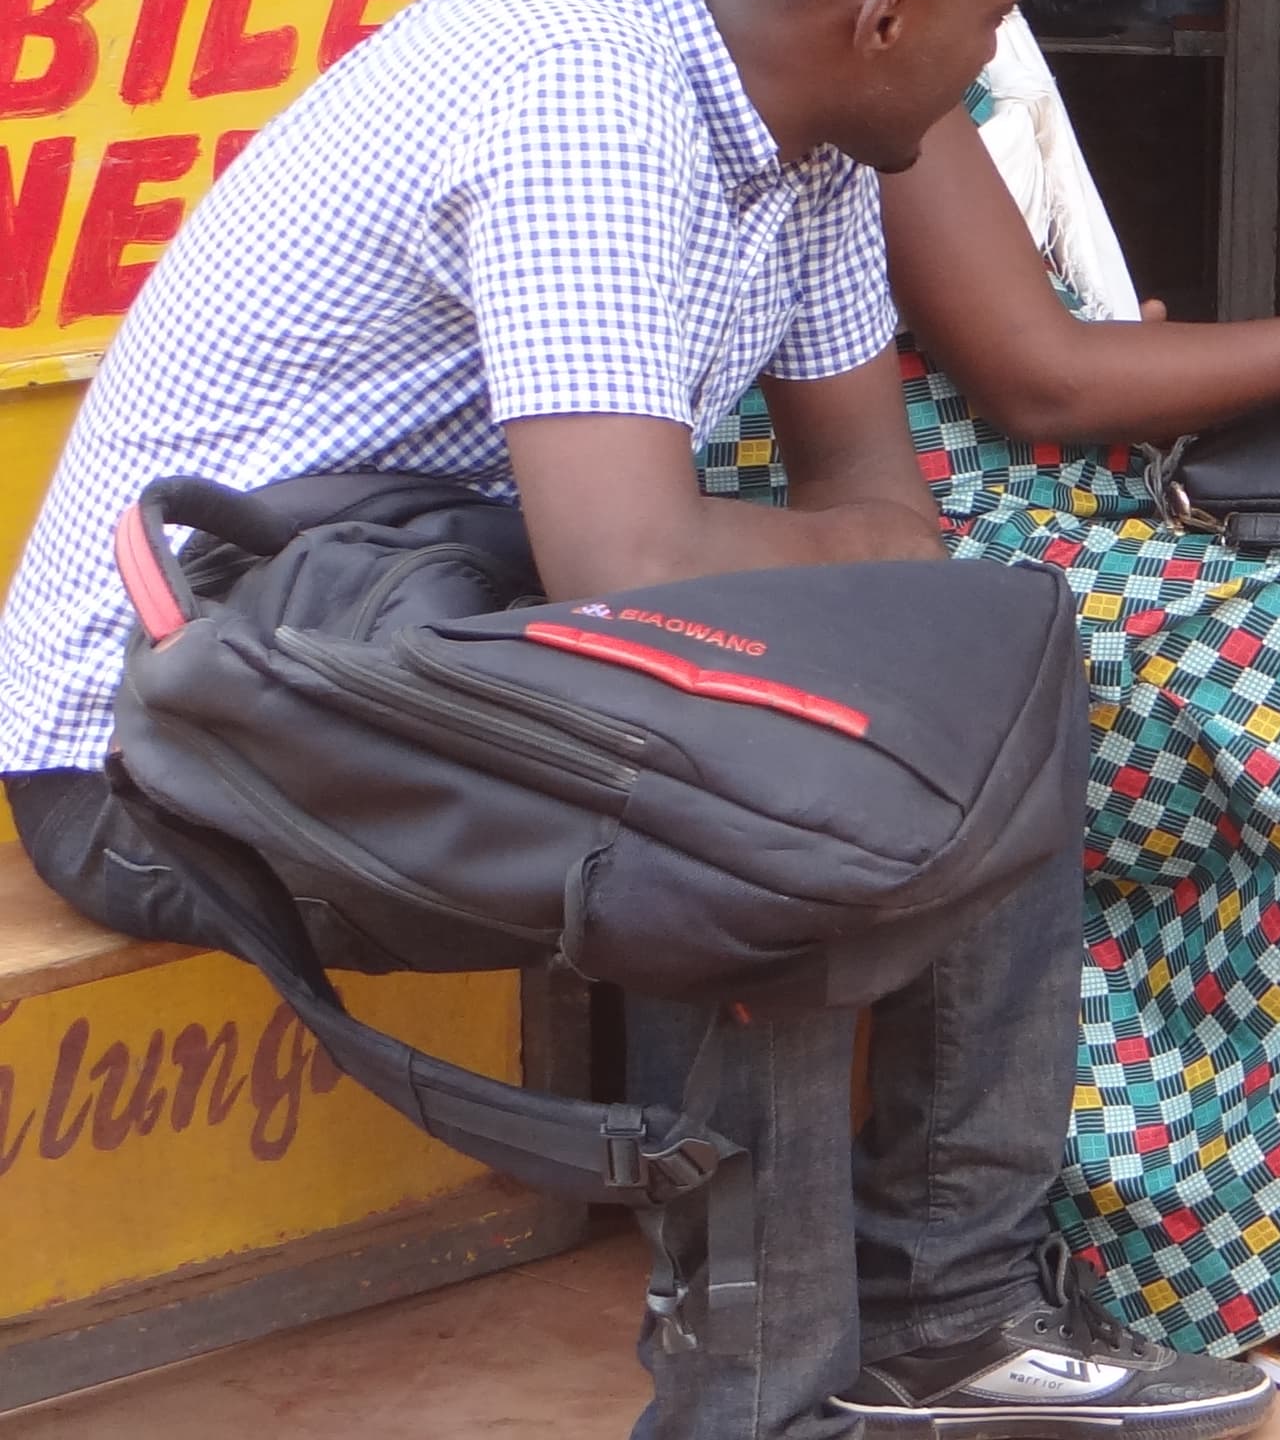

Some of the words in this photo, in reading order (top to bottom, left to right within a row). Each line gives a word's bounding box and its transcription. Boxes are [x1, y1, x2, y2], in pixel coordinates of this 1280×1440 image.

[0, 129, 269, 329] NE
[617, 607, 768, 657] BIAOWANG
[1009, 1371, 1065, 1391] warrior
